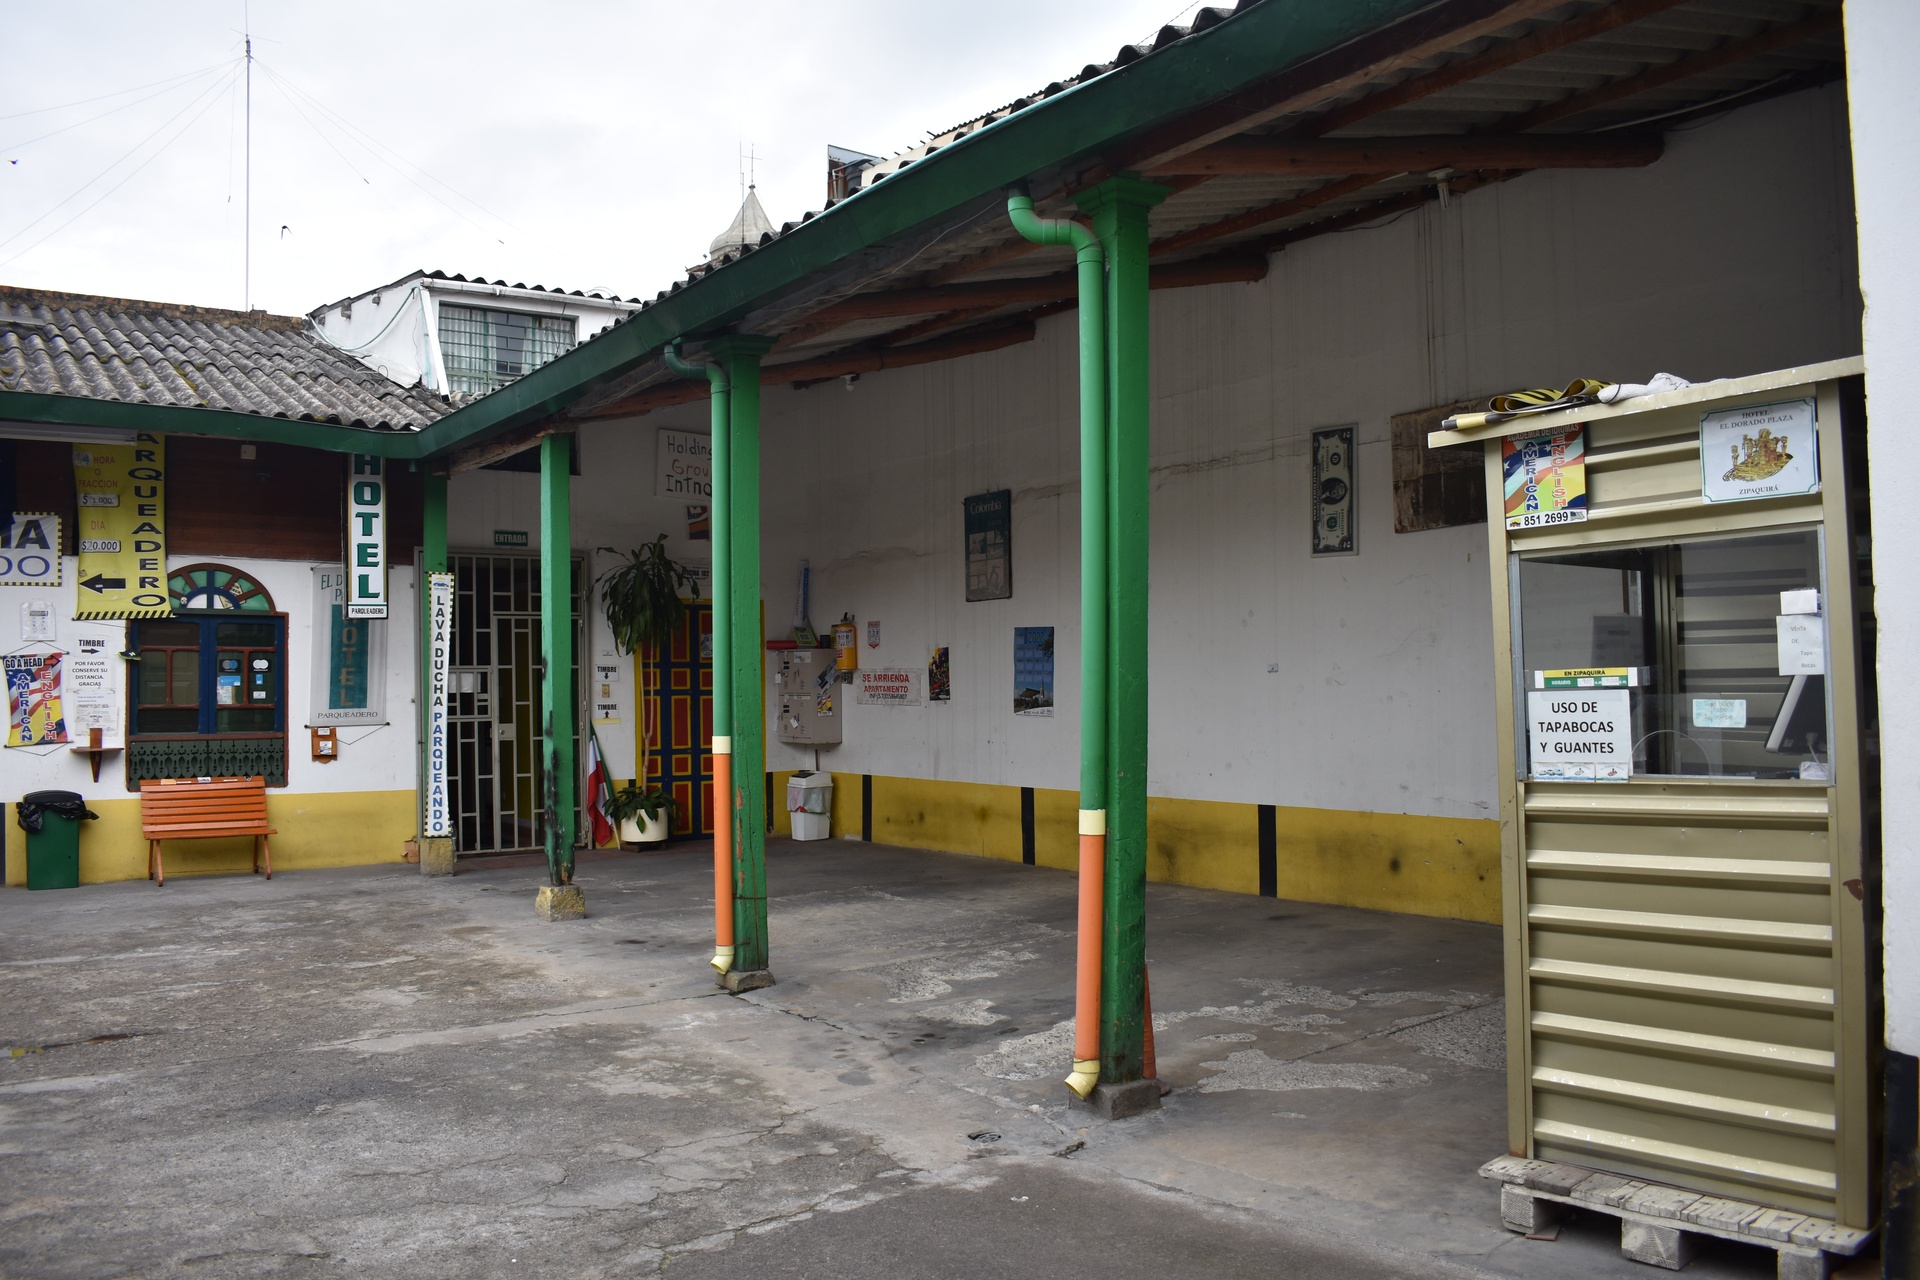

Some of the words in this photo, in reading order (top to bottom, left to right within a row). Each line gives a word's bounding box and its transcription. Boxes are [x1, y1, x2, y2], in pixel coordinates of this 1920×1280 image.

[1742, 410, 1769, 419] HOTEL
[1731, 419, 1766, 429] DORADO
[1767, 415, 1794, 424] PLAZA
[1507, 431, 1540, 442] ACADEMIA
[1541, 428, 1550, 437] DE
[1551, 424, 1579, 435] IDIOMAS
[93, 456, 115, 464] HORA
[95, 468, 102, 476] O
[671, 459, 709, 477] Grou
[1551, 436, 1568, 508] ENGLISH
[1522, 441, 1540, 511] AMERICAN
[78, 480, 118, 488] FRACCION
[1738, 484, 1779, 495] ZIPAQUIRÁ
[970, 500, 1002, 515] Colombia
[91, 520, 106, 530] DIA
[128, 434, 166, 607] ARQUEADERO
[1524, 515, 1541, 526] 851
[1544, 512, 1569, 524] 2699
[354, 454, 382, 598] HOTEL
[495, 533, 527, 543] ENTRADA
[82, 540, 118, 551] $20.000
[321, 574, 333, 590] EL
[434, 596, 445, 642] LAVA
[79, 639, 105, 647] TIMBRE
[1028, 631, 1045, 644] 2022
[5, 659, 16, 669] GO
[17, 659, 22, 668] A
[23, 658, 42, 668] HEAD
[339, 625, 358, 706] OTEL
[433, 648, 444, 706] DUCHA
[862, 673, 871, 683] SE
[873, 673, 910, 683] ARRIENDA
[864, 685, 909, 693] APARTAMENTO
[17, 673, 32, 742] AMERICAN
[41, 671, 57, 740] ENGLISH
[1551, 702, 1578, 713] USO
[1581, 702, 1598, 713] DE
[317, 711, 378, 720] PARQUEADERO
[1538, 721, 1614, 733] TAPABOCAS
[1540, 742, 1548, 753] Y
[1554, 742, 1614, 754] GUANTES
[432, 712, 443, 832] PARQUEANDO
